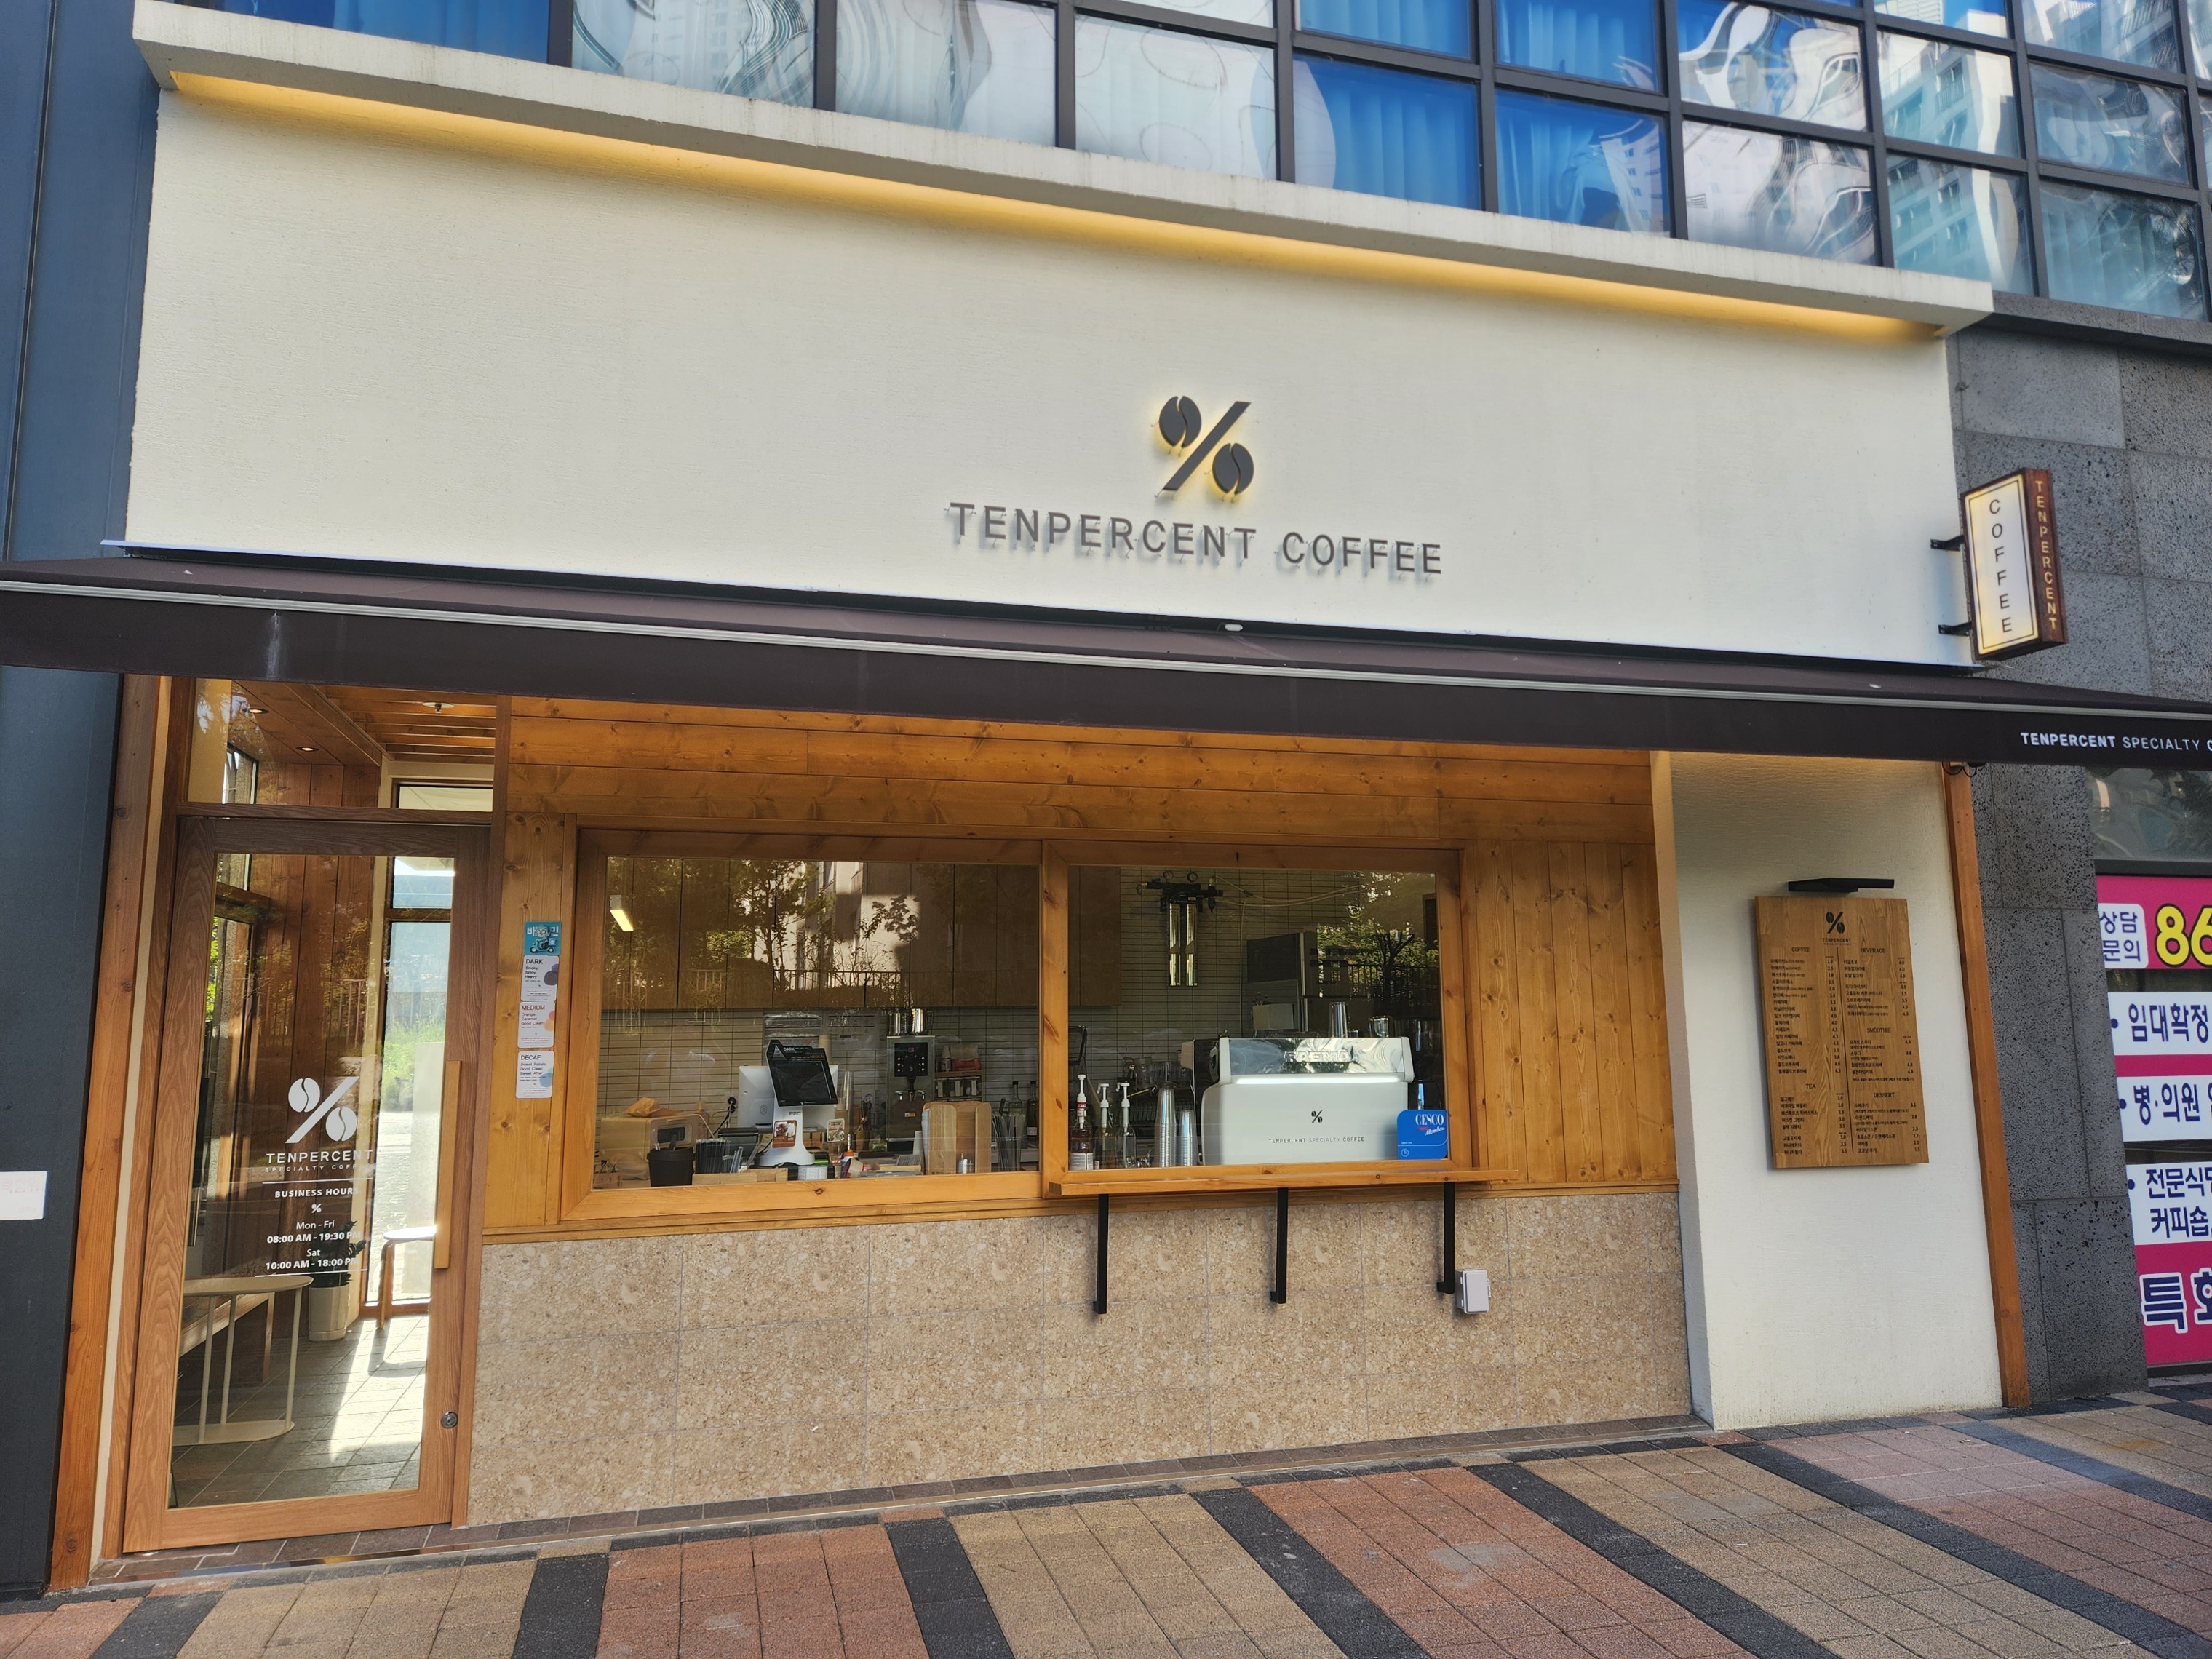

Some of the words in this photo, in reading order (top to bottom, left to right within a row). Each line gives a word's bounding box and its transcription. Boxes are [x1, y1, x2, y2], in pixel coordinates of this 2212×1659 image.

[950, 502, 1256, 559] TENPERCENT
[1282, 532, 1441, 574] COFFEE
[2035, 480, 2057, 629] TENPERCENT
[1989, 499, 2013, 633] COFFEE
[2021, 732, 2115, 747] TENPERCENT
[2123, 737, 2200, 751] SPECIALTY
[2099, 912, 2138, 934] 상담
[2103, 939, 2141, 962] 문의
[2128, 1003, 2209, 1043] 임대확정
[1415, 1114, 1444, 1125] CESCO
[266, 1150, 373, 1163] TENPERCENT
[275, 1189, 322, 1198] BUSINESS
[325, 1187, 359, 1195] HOURS
[324, 1220, 335, 1228] Fri
[267, 1235, 293, 1244] 08:00
[295, 1234, 311, 1242] AM
[319, 1233, 345, 1241] 19:30
[266, 1262, 292, 1270] 10:00
[293, 1260, 309, 1268] AM
[317, 1259, 343, 1267] 18:00
